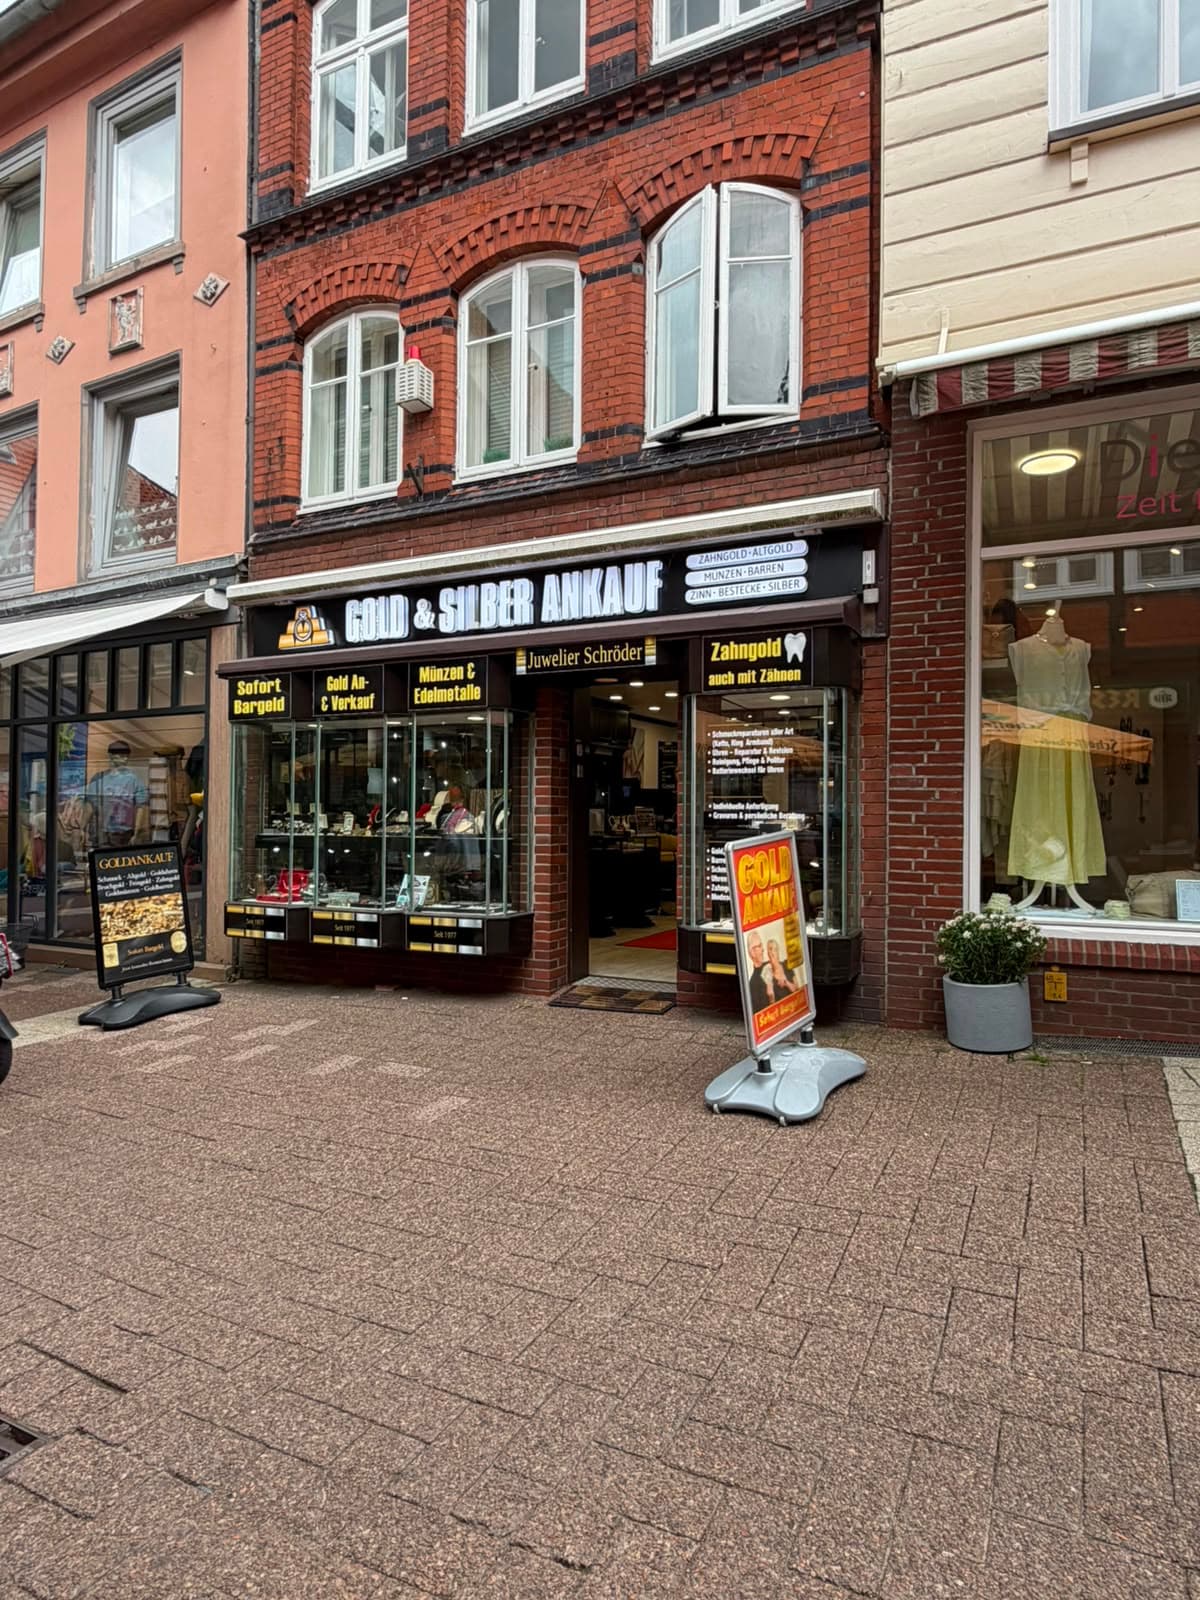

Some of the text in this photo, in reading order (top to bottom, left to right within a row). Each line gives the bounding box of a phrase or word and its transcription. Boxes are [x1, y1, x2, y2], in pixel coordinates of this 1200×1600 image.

[718, 583, 761, 597] BESTECKE
[768, 579, 800, 592] SILBER
[345, 560, 663, 643] GOLD & SILBER ANKAUF
[528, 642, 643, 669] Juwelier Schröder
[711, 637, 781, 662] Zahngold
[419, 662, 475, 683] Münzen &
[708, 671, 735, 686] auch
[738, 670, 757, 684] mit
[237, 678, 282, 695] Sofort
[326, 674, 370, 692] Gold An-
[321, 693, 375, 711] & Verkauf
[413, 684, 481, 705] Edelmetalle
[233, 696, 285, 715] Bargeld
[99, 852, 174, 870] GOLDANKAUF
[738, 846, 792, 895] GOLD
